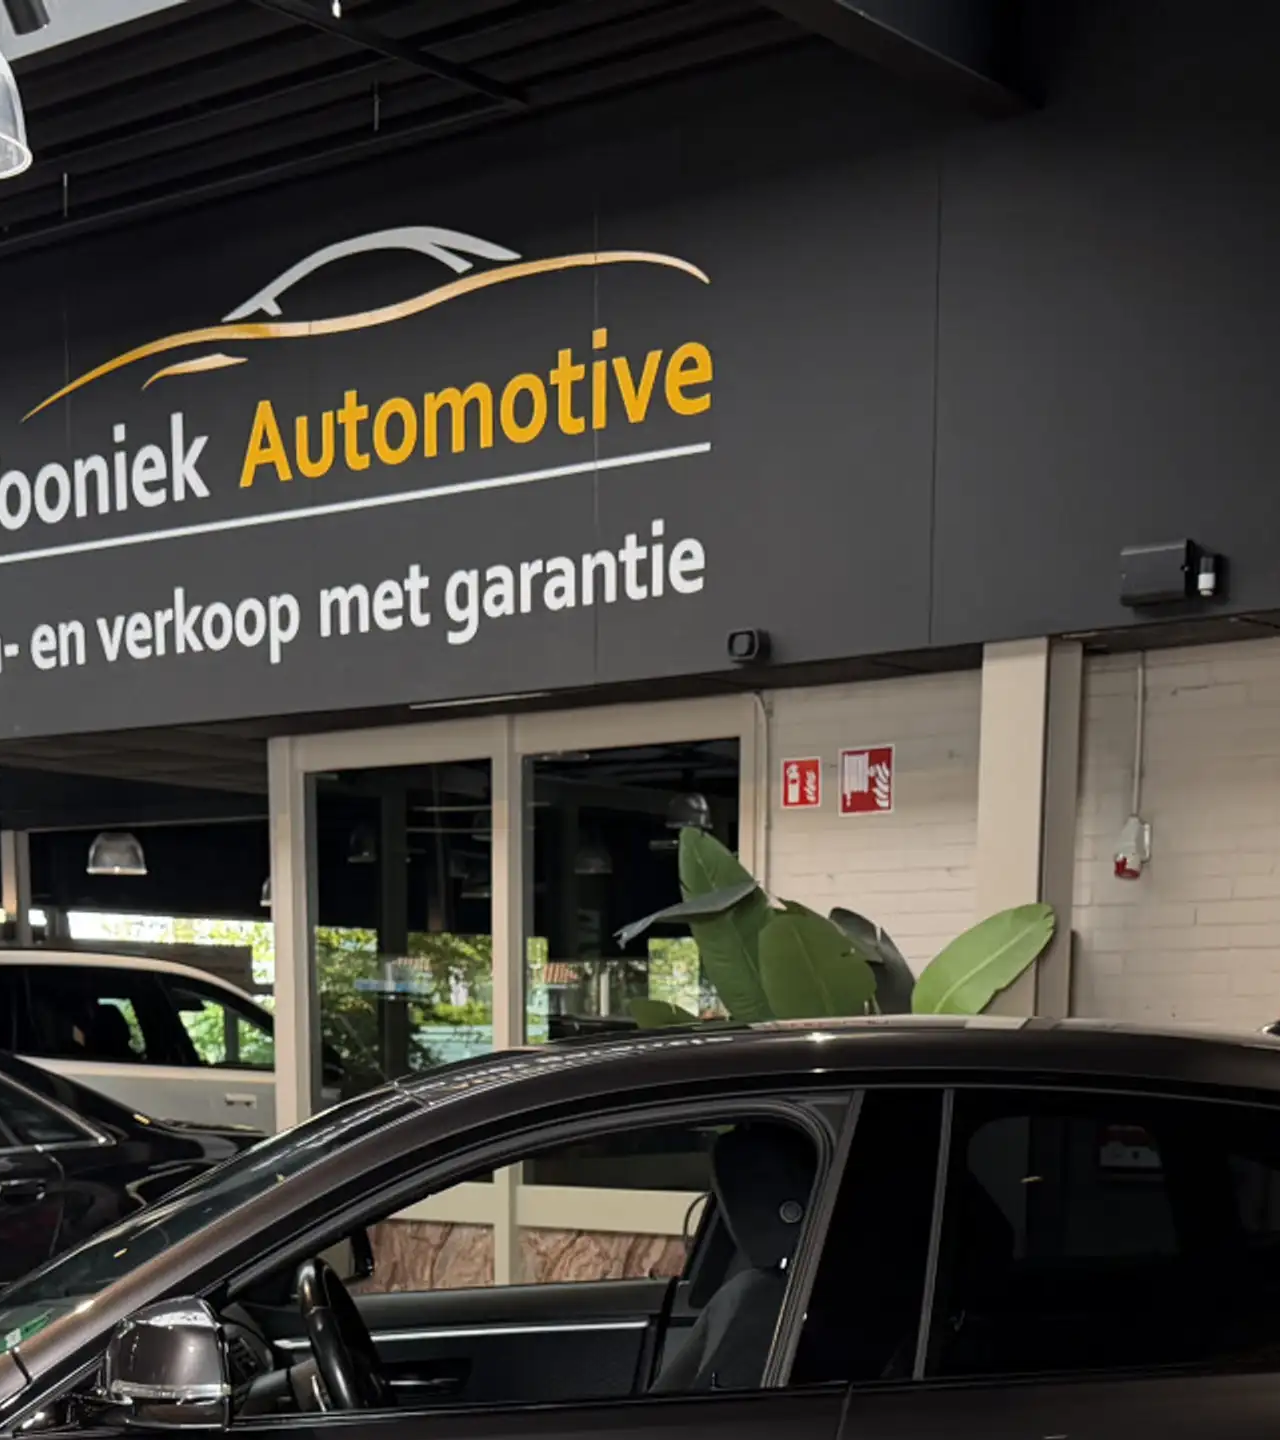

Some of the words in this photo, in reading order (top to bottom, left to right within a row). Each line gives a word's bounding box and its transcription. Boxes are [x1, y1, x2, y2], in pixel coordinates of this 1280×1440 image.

[239, 327, 713, 488] Automotive
[31, 620, 86, 670] en
[96, 586, 300, 664] verkoop
[320, 563, 431, 638] met
[445, 518, 705, 645] garantie
